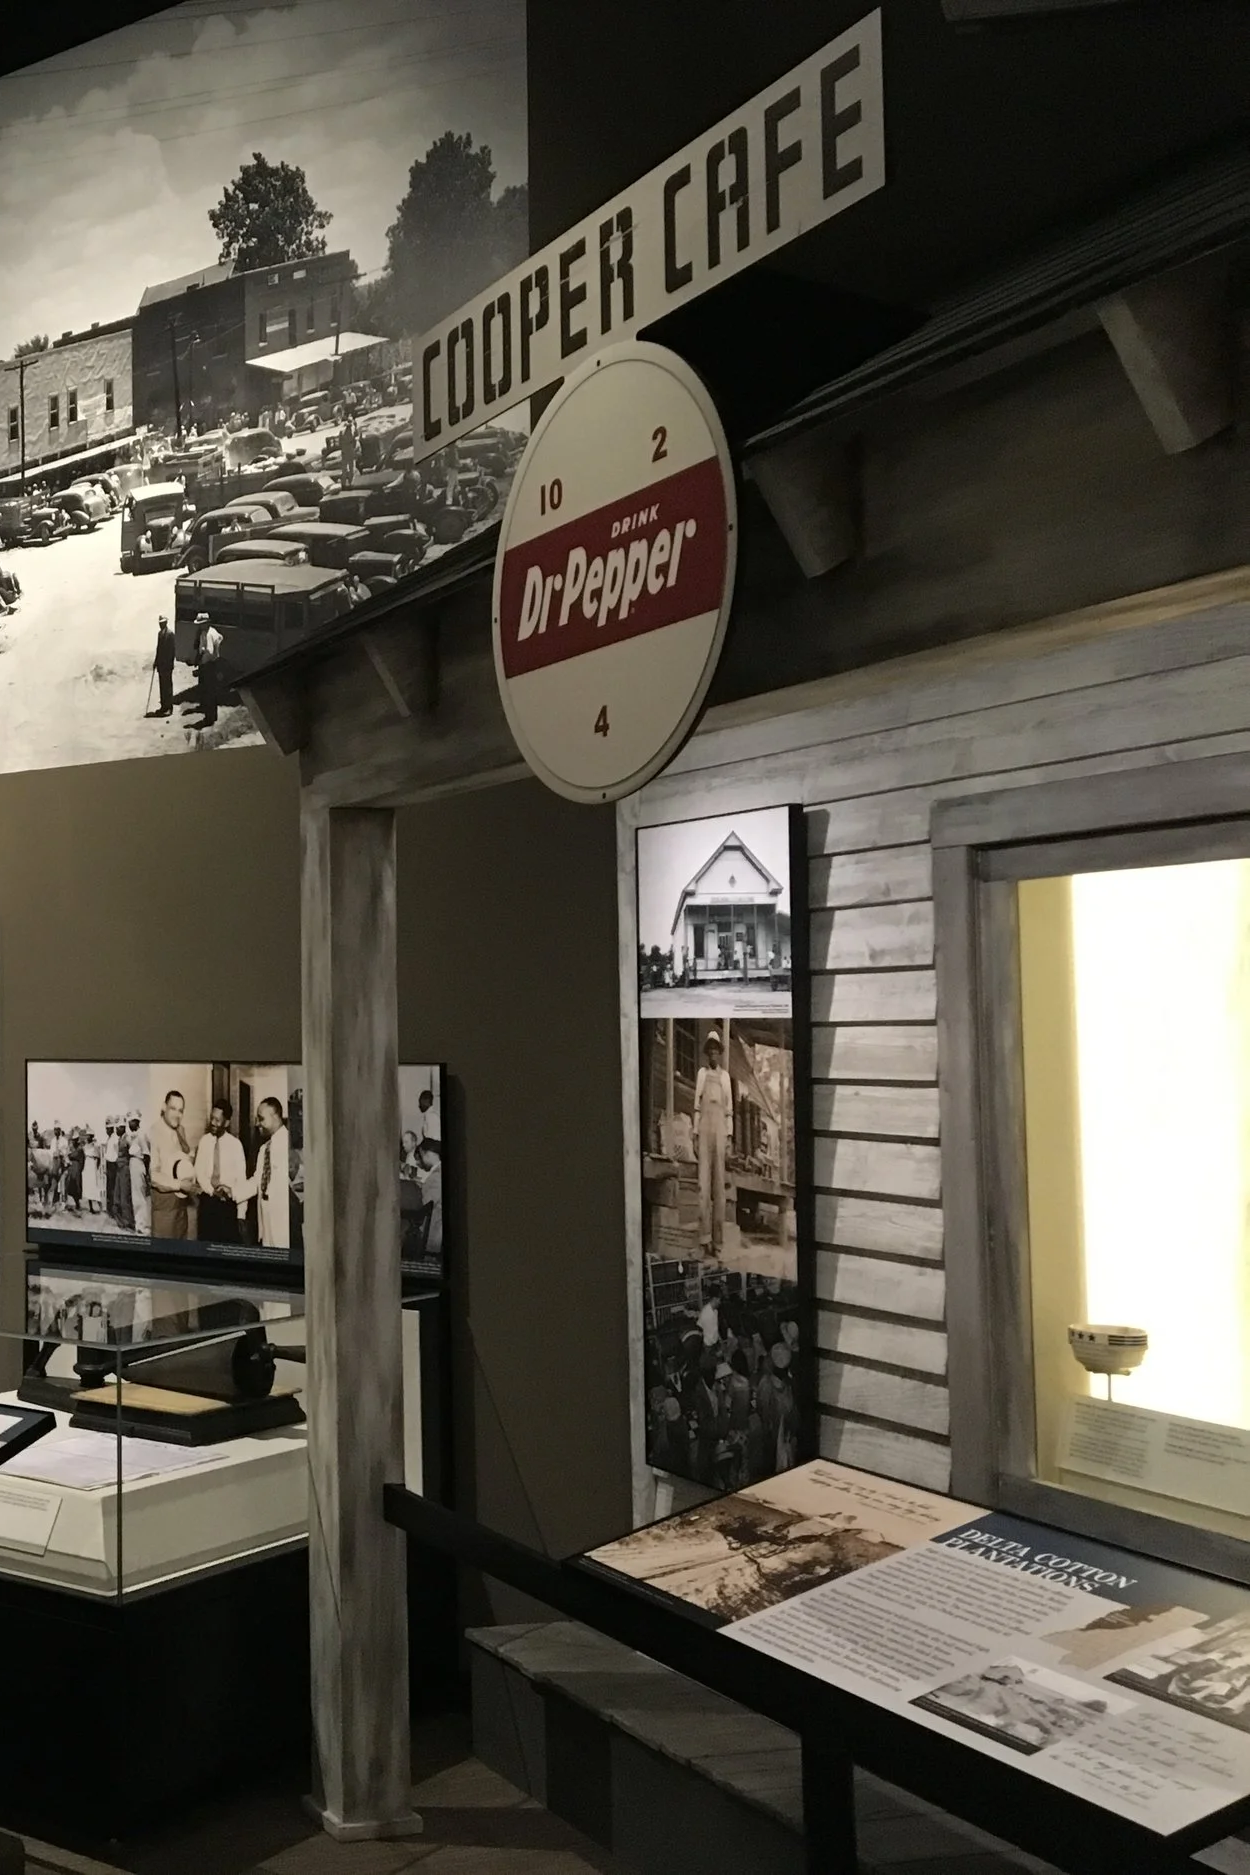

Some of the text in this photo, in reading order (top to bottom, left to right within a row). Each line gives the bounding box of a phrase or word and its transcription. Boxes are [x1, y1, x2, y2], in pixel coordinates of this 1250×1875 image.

[422, 43, 864, 442] COOPER CAFE
[651, 425, 668, 463] 2
[540, 477, 563, 516] 10
[611, 503, 661, 539] DRINK
[594, 705, 610, 737] 4
[943, 1537, 1101, 1592] PLANTATIONS
[959, 1529, 1138, 1589] DELTA COTTON
